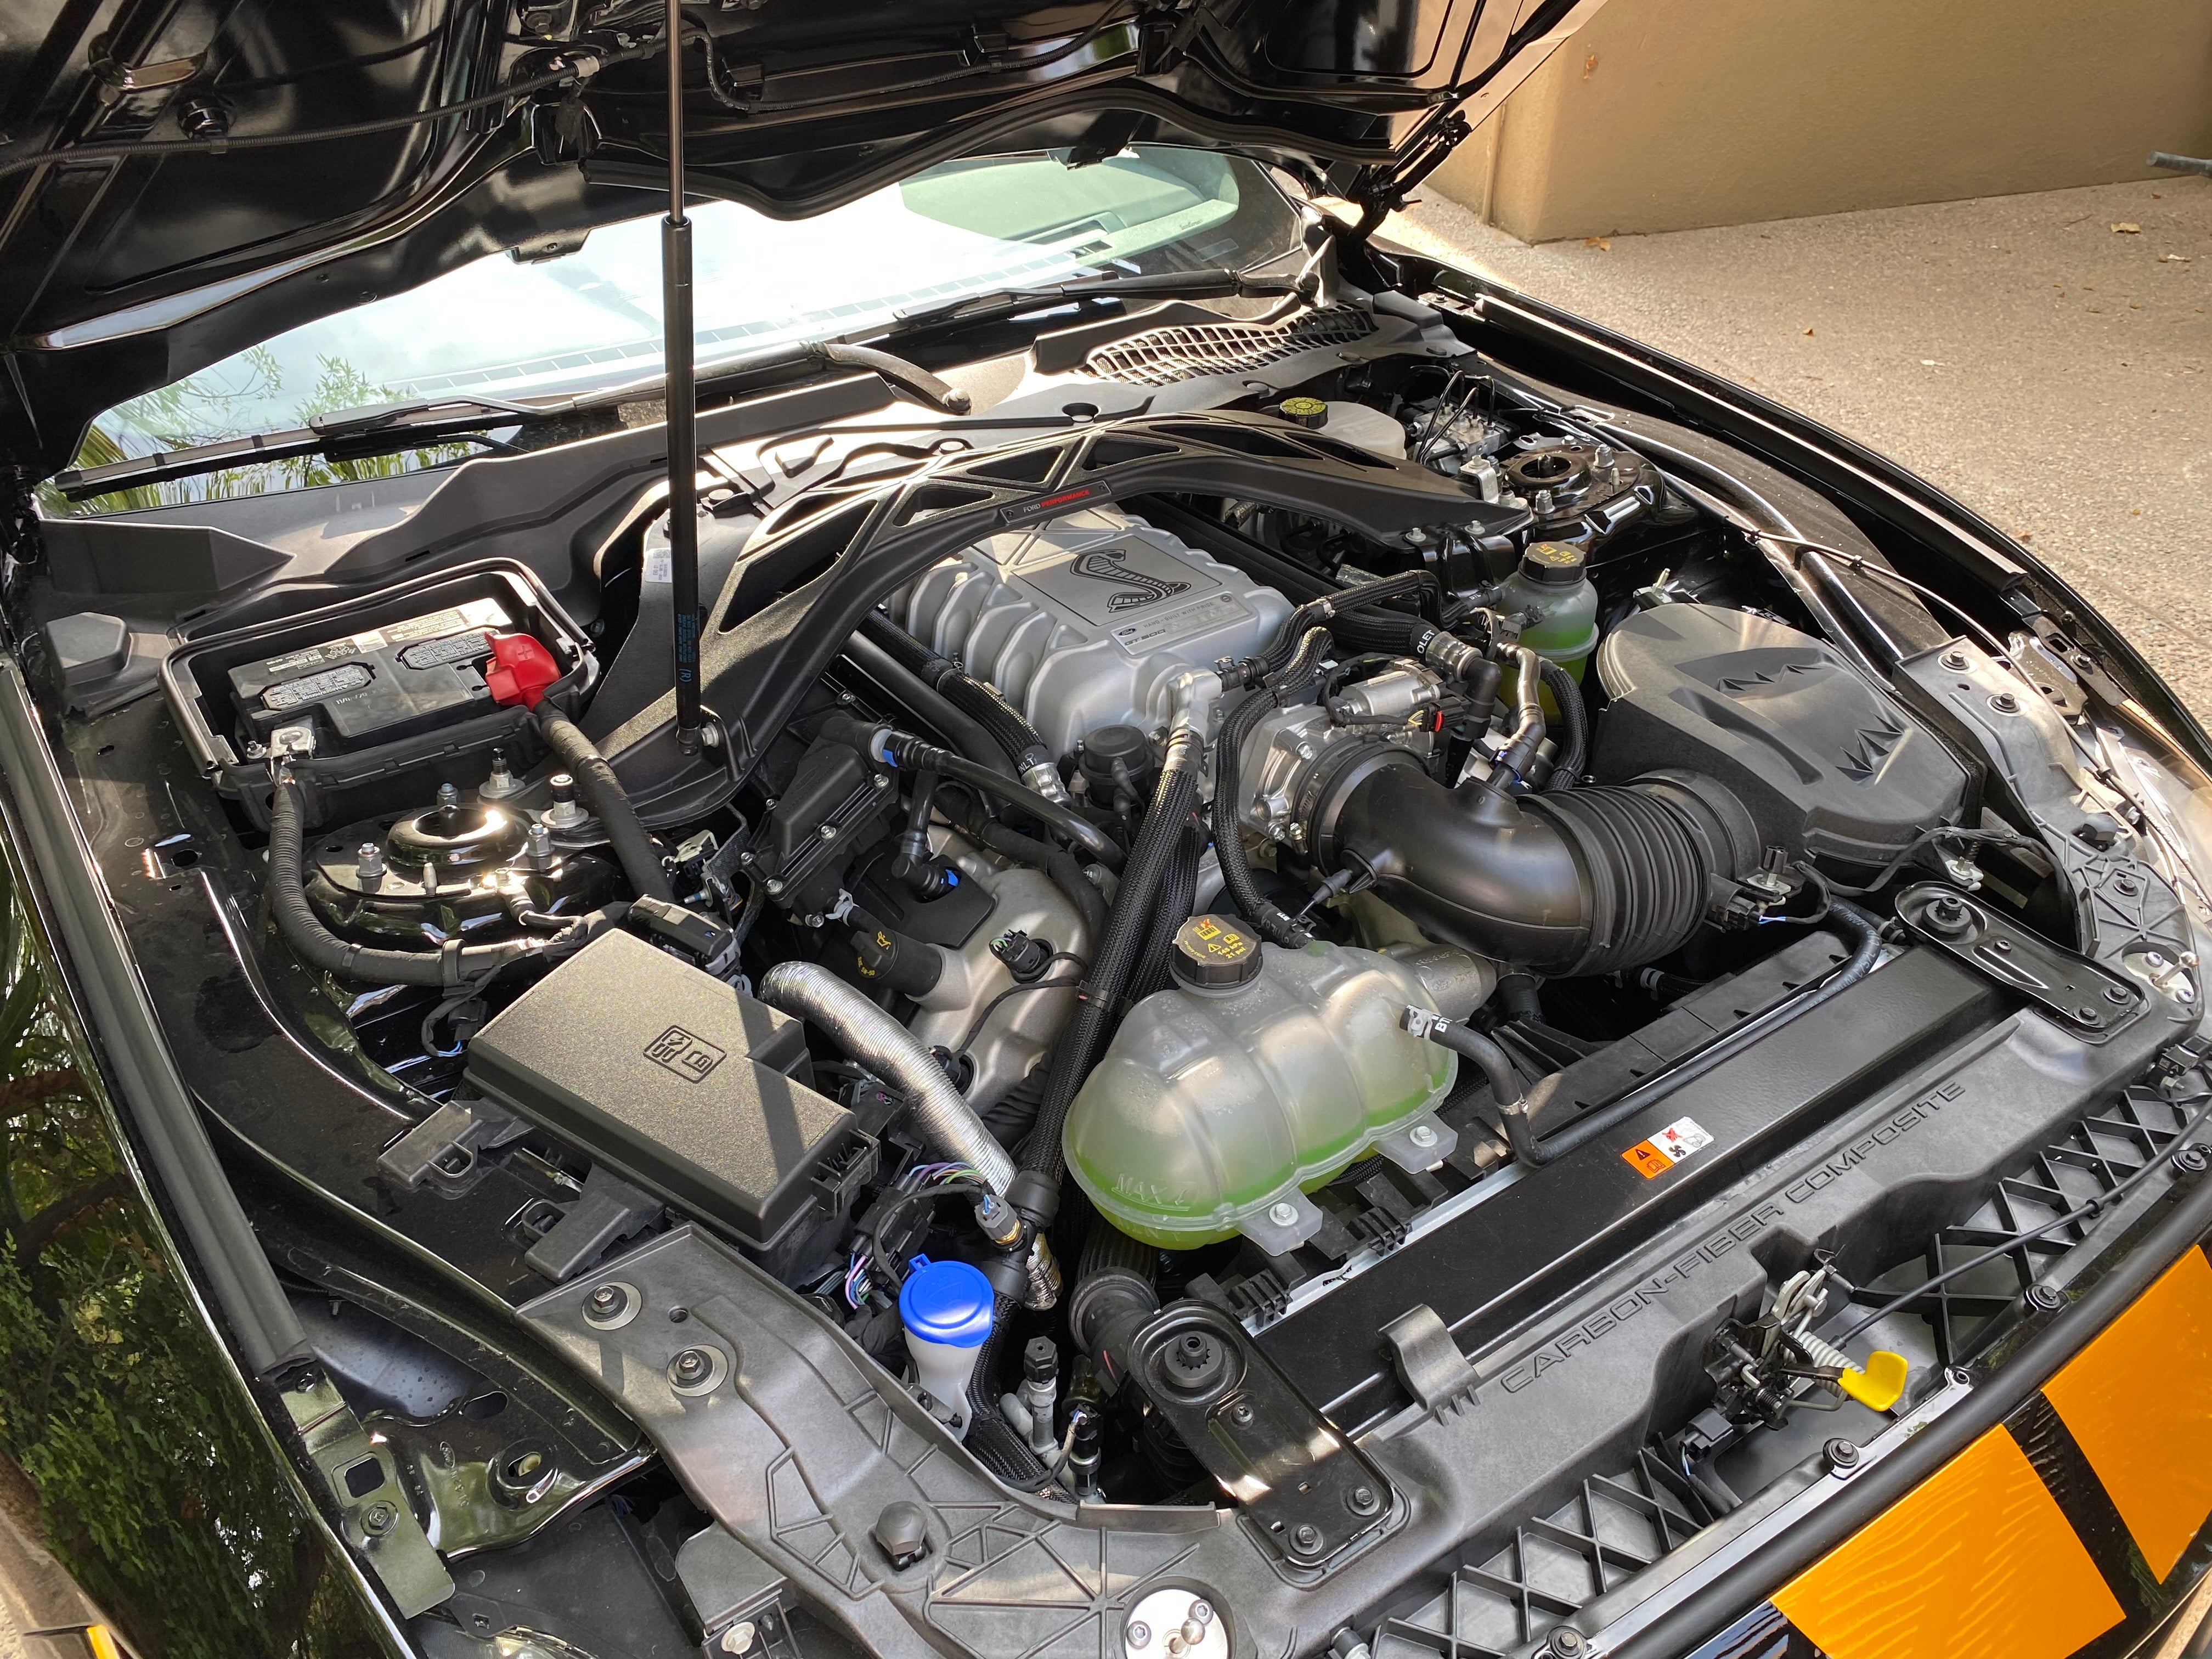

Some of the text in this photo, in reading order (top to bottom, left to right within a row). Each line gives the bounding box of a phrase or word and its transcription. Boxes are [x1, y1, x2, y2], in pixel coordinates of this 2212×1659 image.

[1023, 490, 1090, 513] FORD PERFORMANCE
[1181, 607, 1196, 615] WITH
[1197, 601, 1215, 610] PRIDE
[1417, 629, 1435, 654] OLET
[679, 668, 692, 682] (R)
[1229, 941, 1243, 950] kPa
[1235, 947, 1246, 955] psi
[1115, 1172, 1168, 1205] MAX
[1500, 1081, 1966, 1394] CARBON-FIBER COMPOSITE
